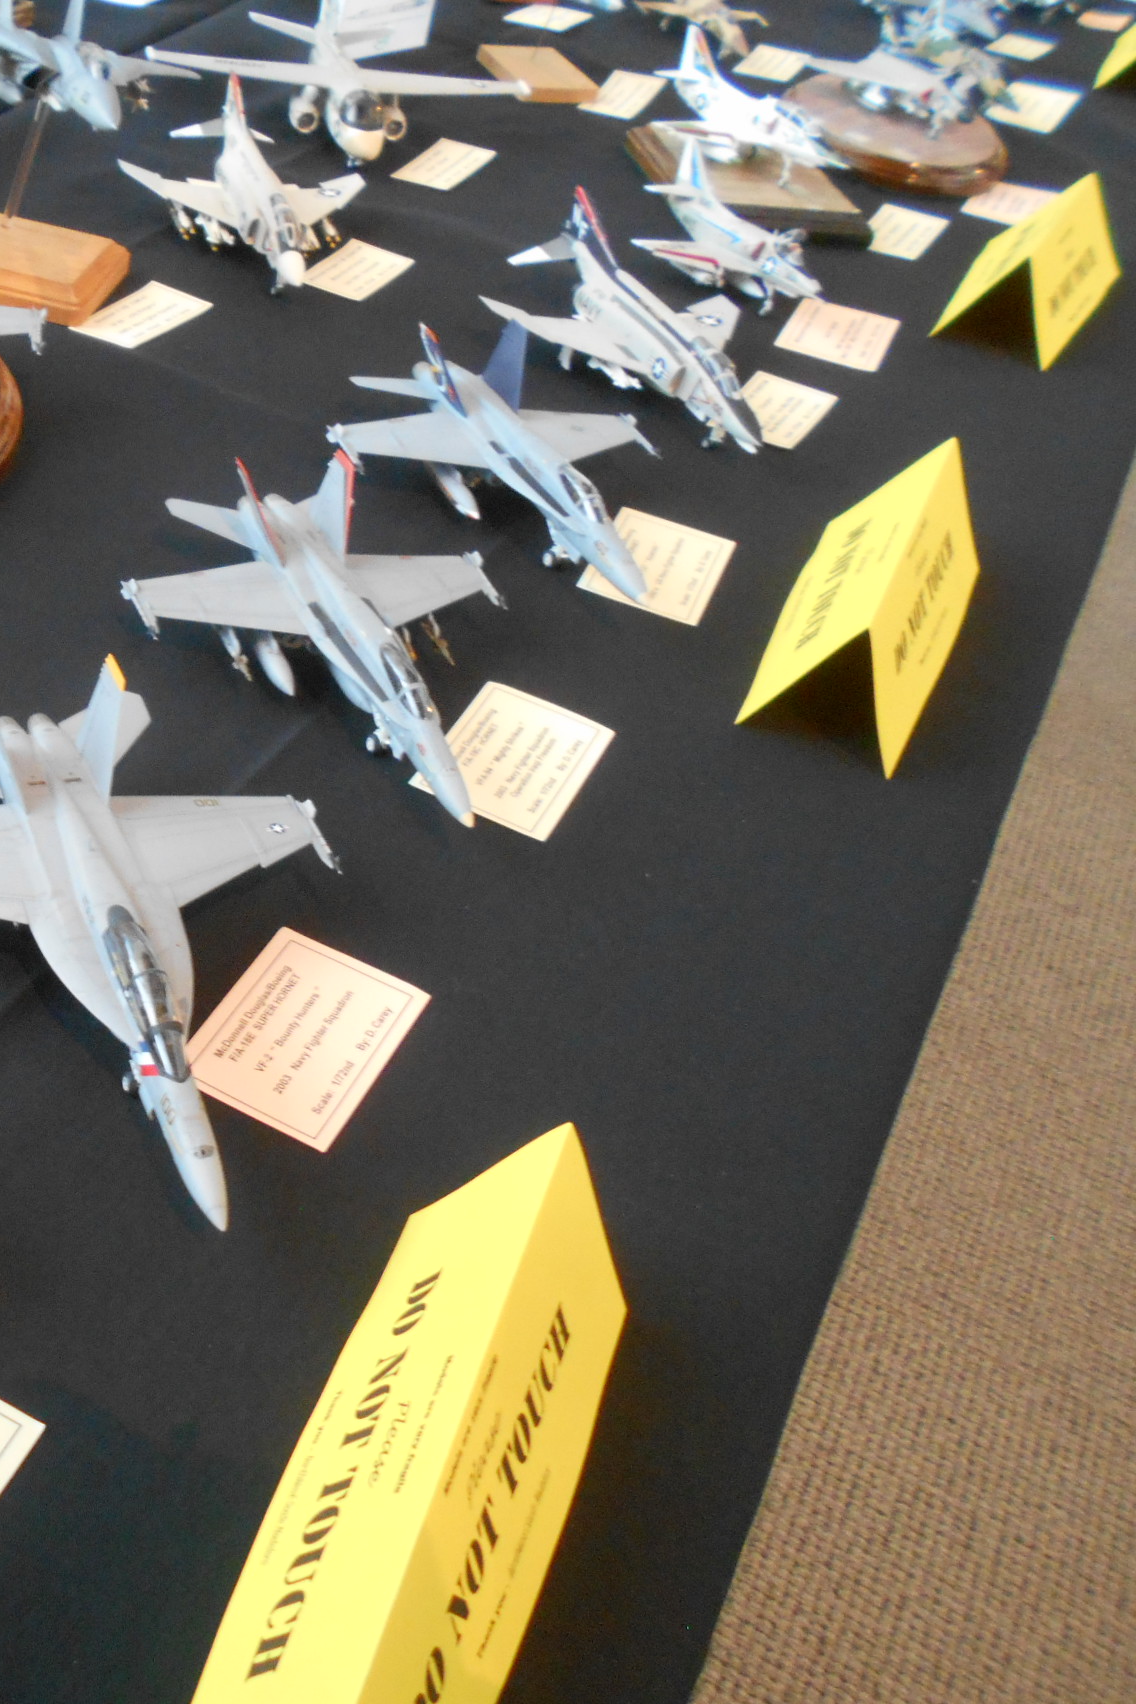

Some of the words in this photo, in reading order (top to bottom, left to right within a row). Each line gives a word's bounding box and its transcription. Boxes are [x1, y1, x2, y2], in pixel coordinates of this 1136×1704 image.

[213, 1018, 248, 1058] McDonnell
[253, 1004, 277, 1030] SUPER
[273, 974, 300, 1004] HORNET
[273, 1021, 300, 1047] Bounty
[290, 1051, 310, 1071] Navy
[303, 1025, 328, 1051] Fighter
[323, 991, 353, 1025] Squadron
[371, 1007, 393, 1028] Carey
[392, 1268, 443, 1336] DO
[341, 1346, 409, 1450] NOT
[367, 1400, 411, 1489] Please
[414, 1646, 445, 1704] O
[444, 1495, 501, 1646] NOT
[496, 1301, 572, 1499] TOUCH
[245, 1463, 358, 1682] TOUCH
